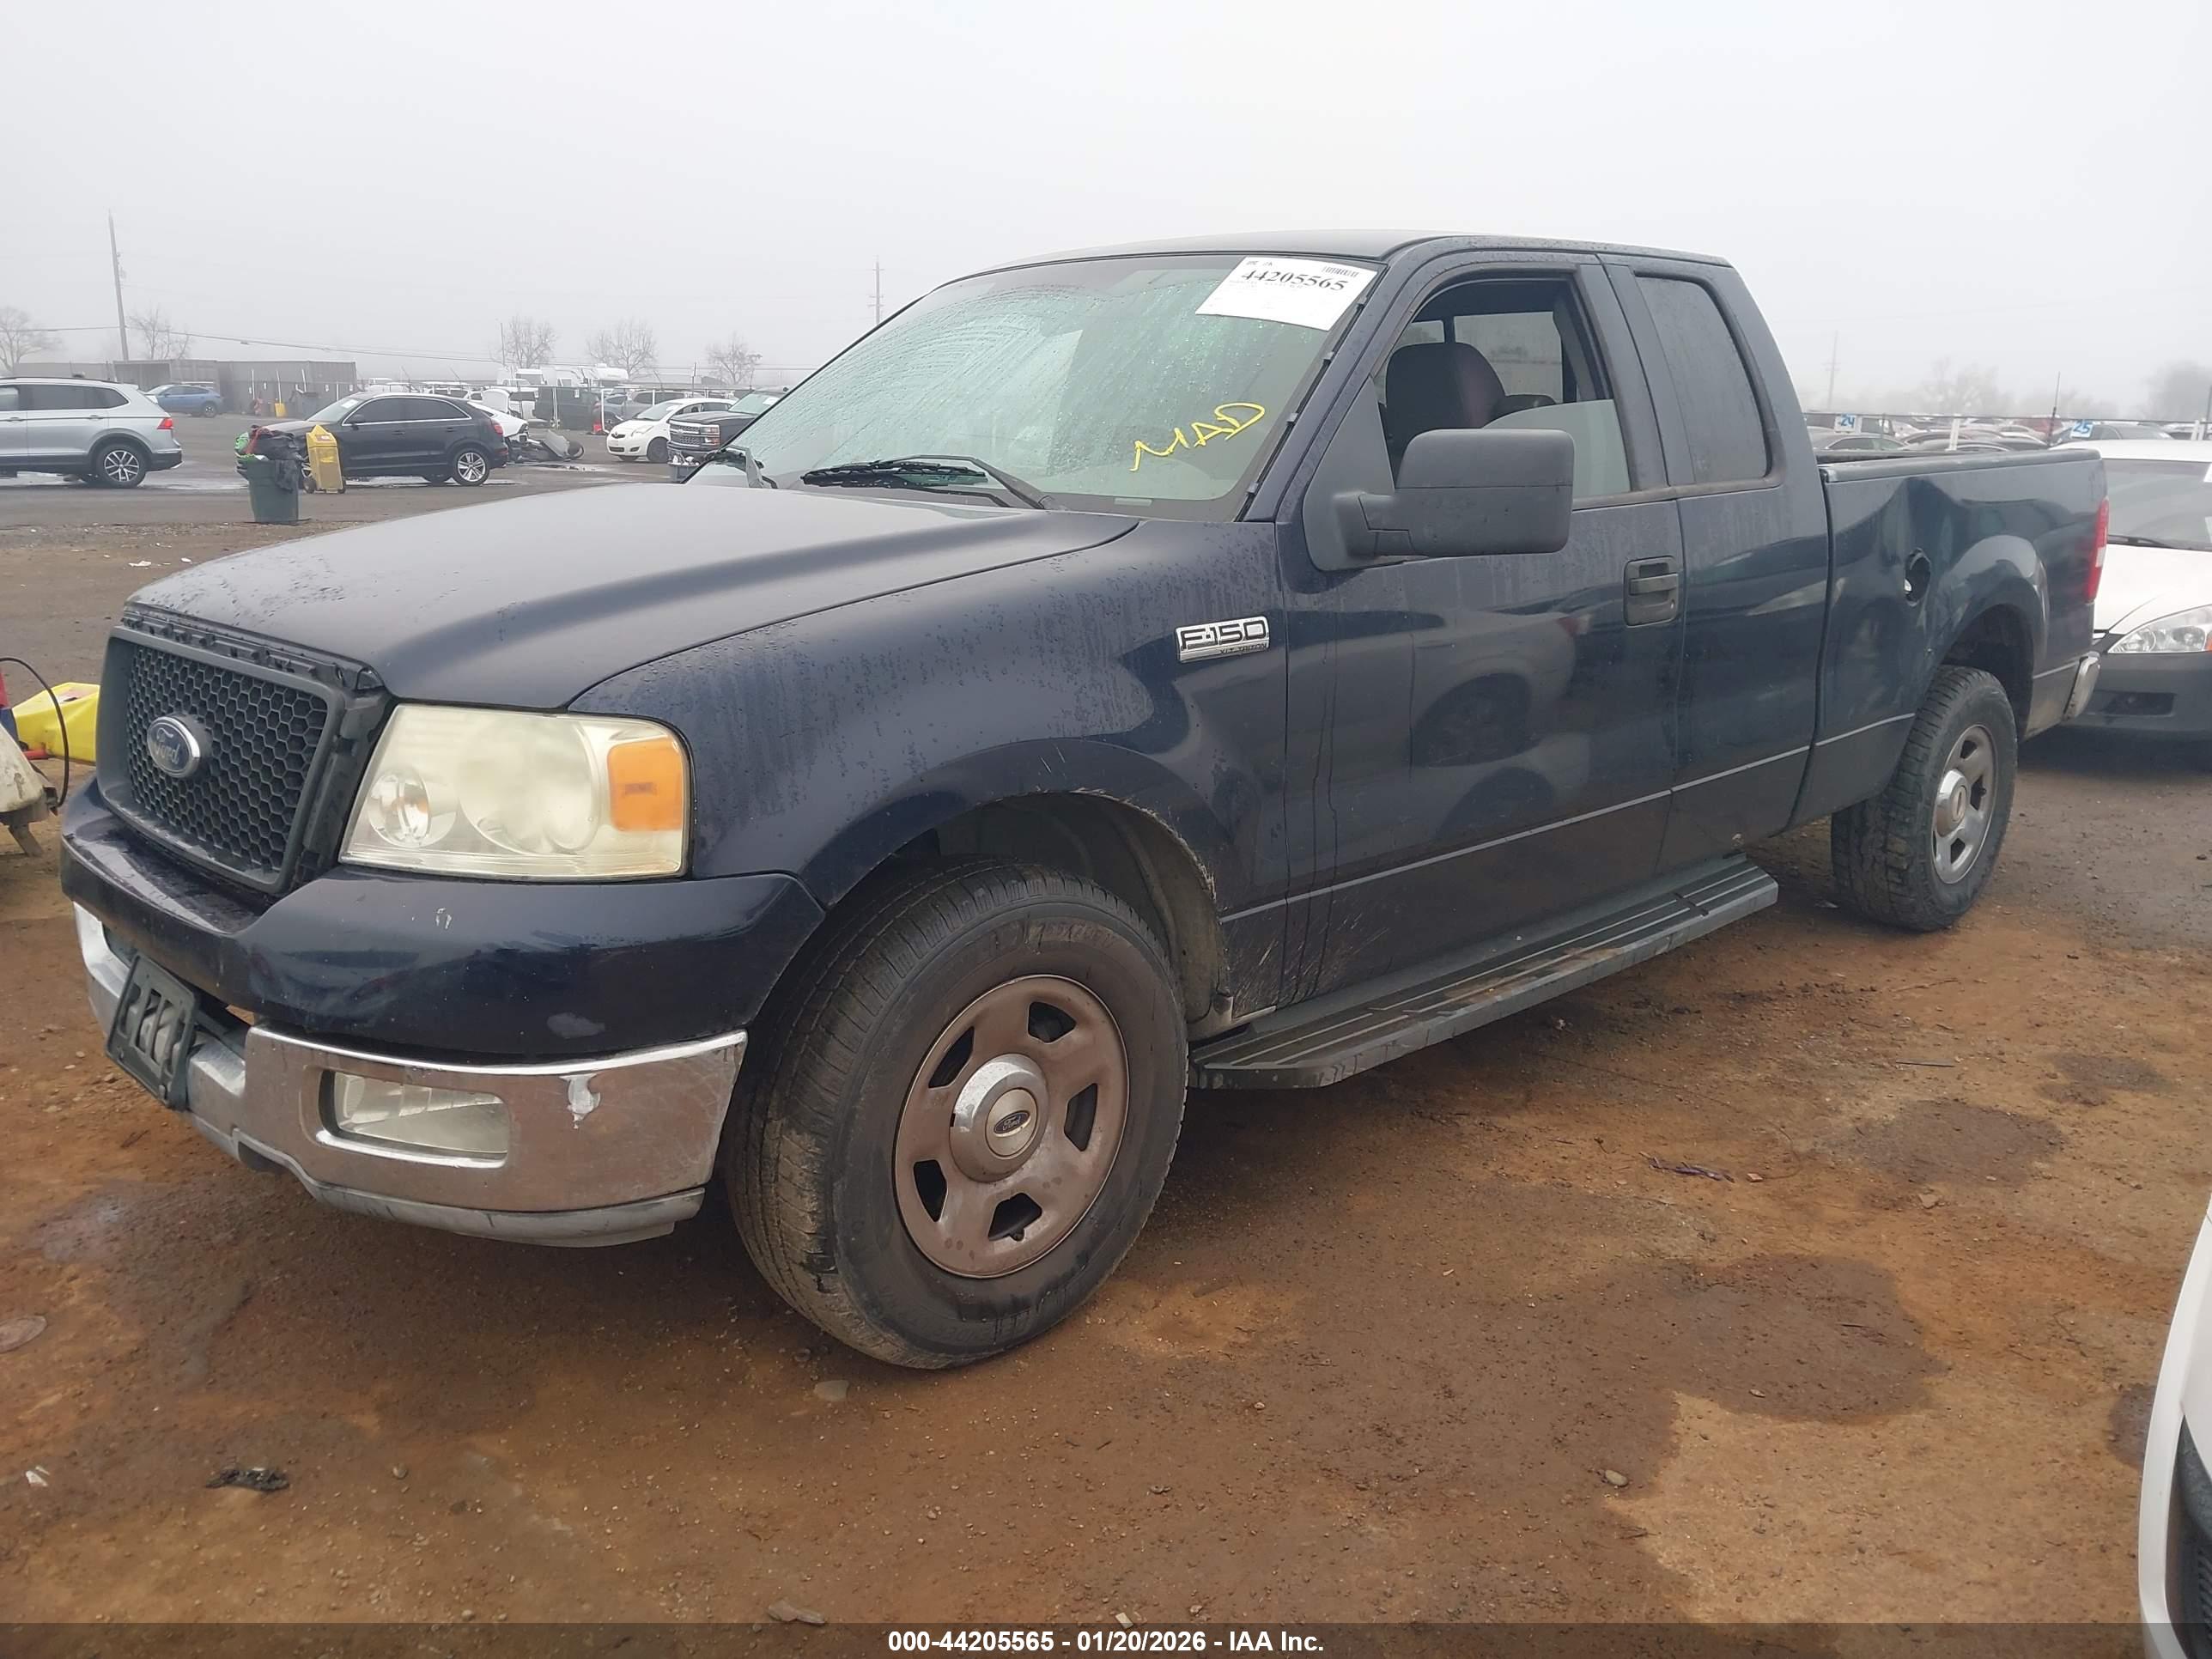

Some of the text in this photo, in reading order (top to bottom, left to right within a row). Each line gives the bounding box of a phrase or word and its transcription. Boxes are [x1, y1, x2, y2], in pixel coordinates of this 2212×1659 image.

[1241, 270, 1349, 291] 44205565
[1128, 402, 1266, 471] MAD
[2073, 418, 2090, 434] 25
